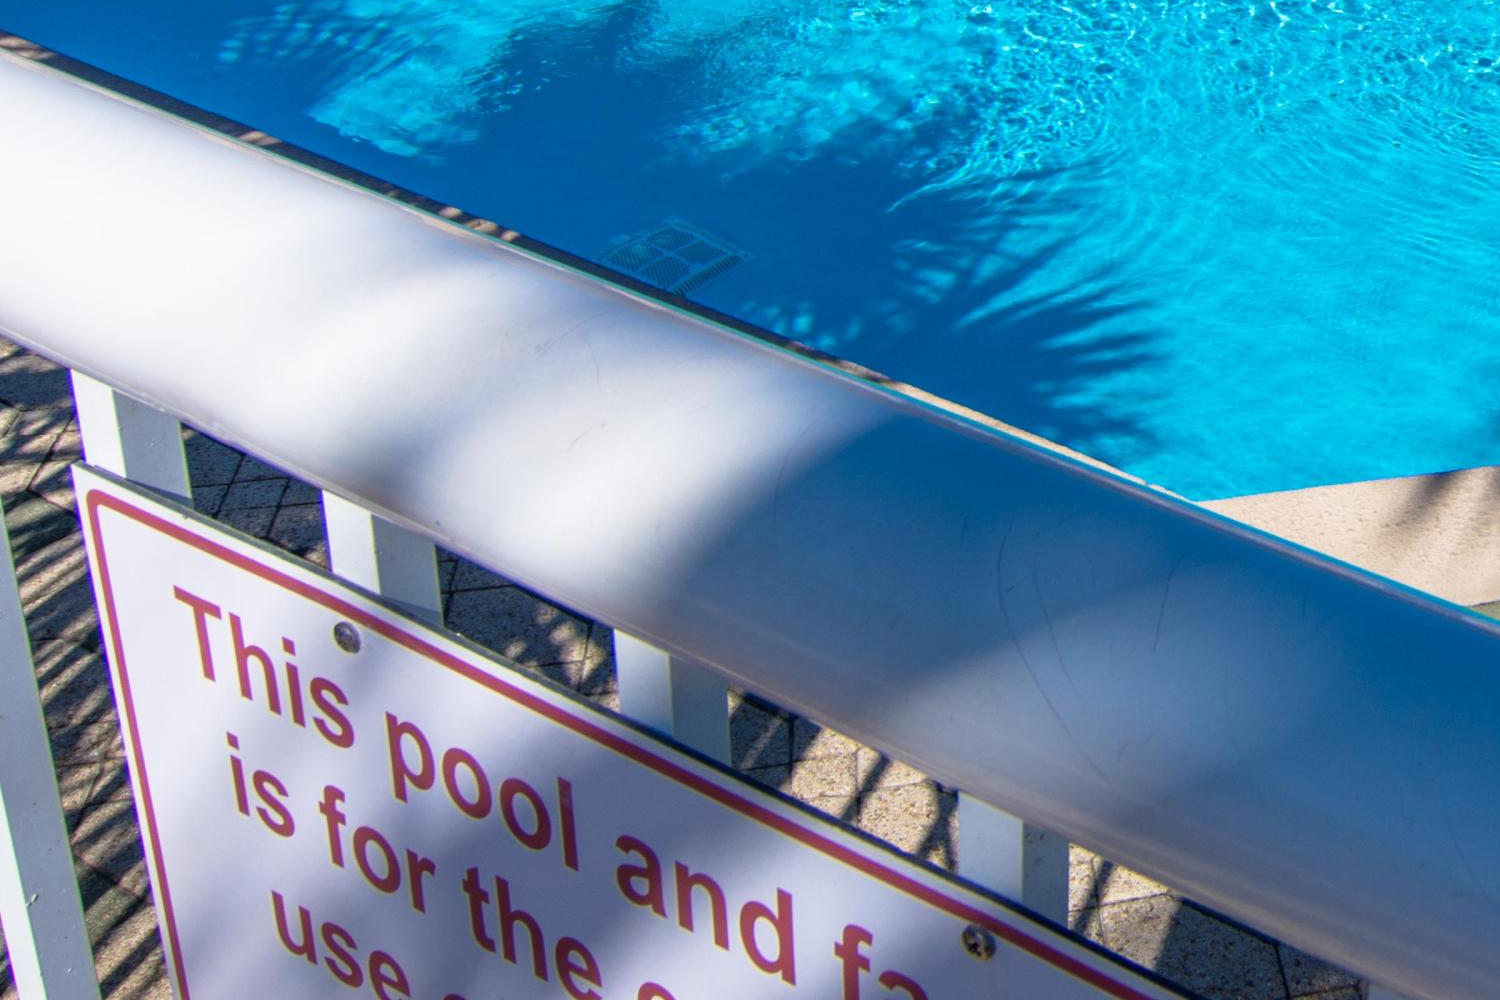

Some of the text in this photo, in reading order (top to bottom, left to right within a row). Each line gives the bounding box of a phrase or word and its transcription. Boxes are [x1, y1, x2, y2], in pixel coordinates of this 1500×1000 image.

[173, 584, 356, 749] This
[384, 710, 579, 871] pool
[614, 833, 797, 987] and
[225, 730, 604, 1000] is for the
[270, 888, 413, 1000] use
